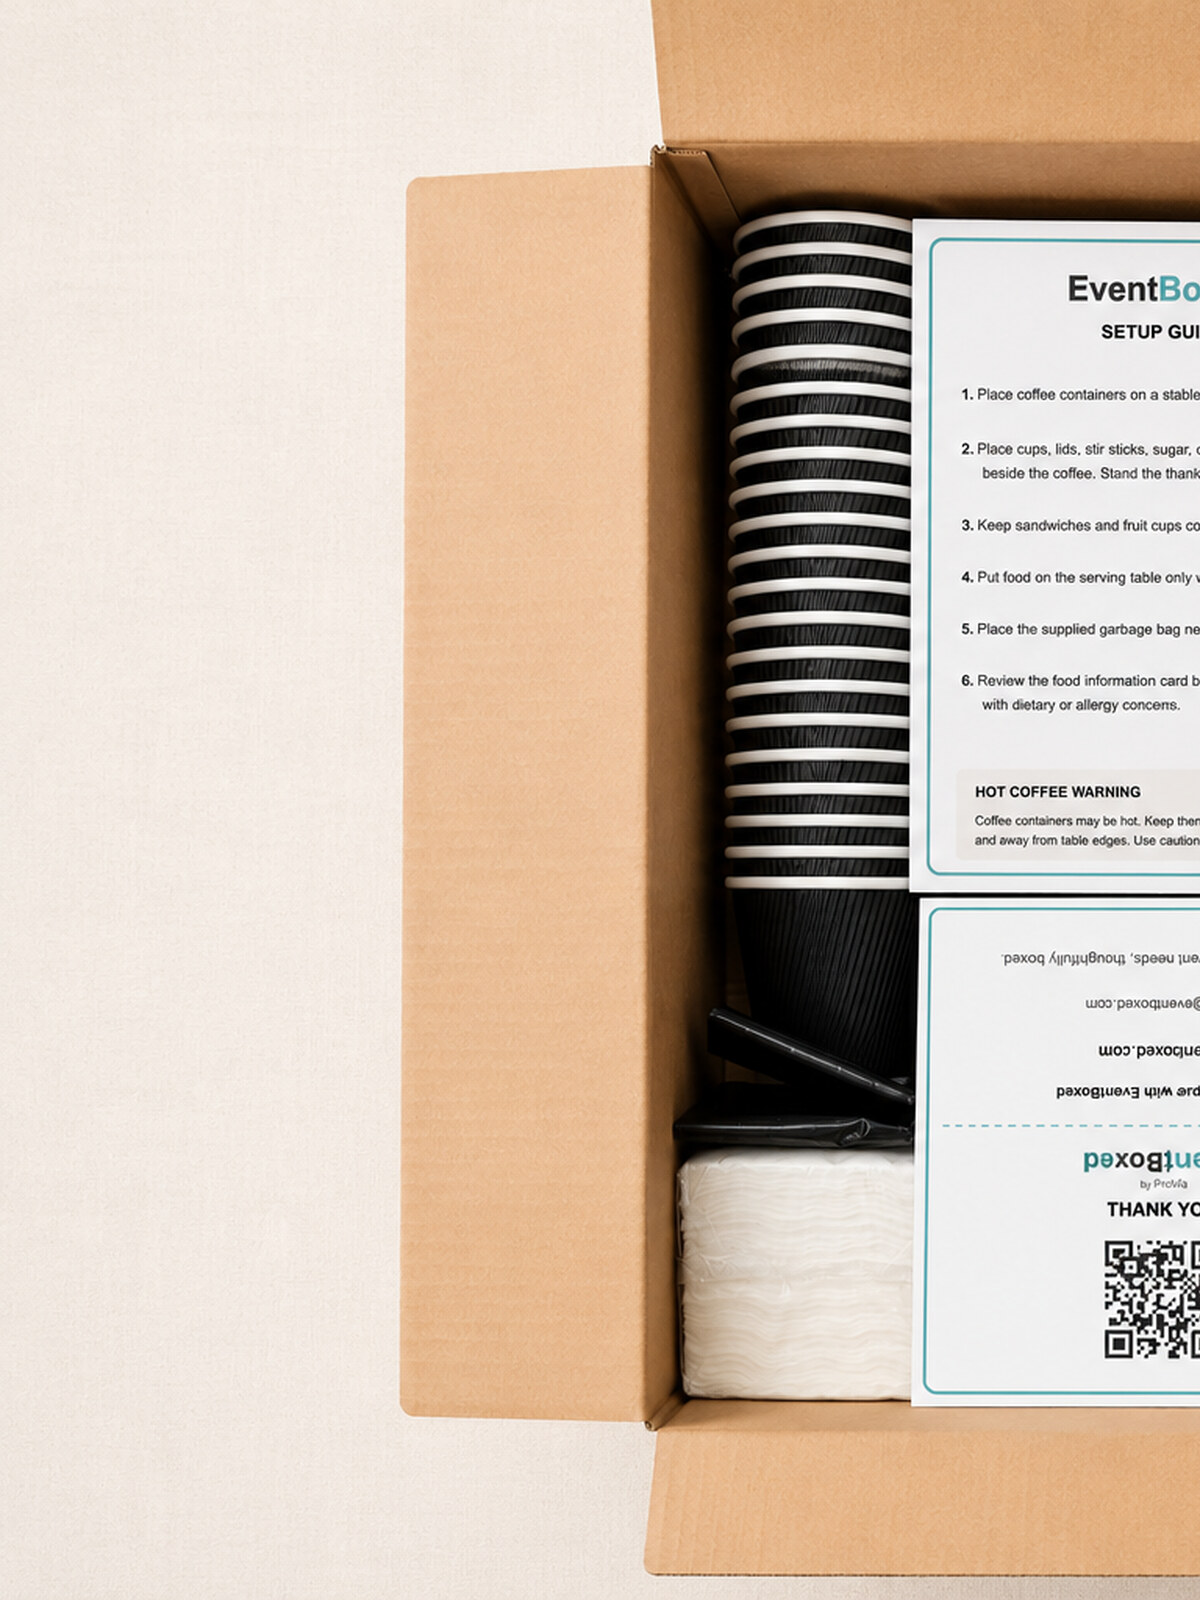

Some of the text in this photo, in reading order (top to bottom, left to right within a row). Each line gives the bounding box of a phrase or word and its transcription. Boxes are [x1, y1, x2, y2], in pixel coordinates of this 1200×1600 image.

[1101, 323, 1164, 340] SETUP
[961, 387, 974, 401] 1.
[977, 387, 1014, 401] Place
[1016, 387, 1056, 401] coffee
[1058, 388, 1127, 401] containers
[1129, 390, 1147, 401] on
[1149, 390, 1159, 401] a
[961, 442, 975, 456] 2.
[977, 441, 1014, 456] Place
[1016, 444, 1052, 458] cups,
[1055, 442, 1082, 457] lids,
[1084, 442, 1106, 456] stir
[1108, 442, 1149, 457] sticks,
[1152, 445, 1192, 459] sugar,
[982, 466, 1026, 480] beside
[1028, 466, 1050, 480] the
[1052, 466, 1097, 480] coffee.
[1100, 466, 1139, 480] Stand
[1141, 466, 1163, 480] the
[961, 518, 975, 532] 3.
[977, 518, 1012, 534] Keep
[1014, 518, 1092, 532] sandwiches
[1094, 519, 1120, 532] and
[1122, 518, 1148, 532] fruit
[1150, 521, 1183, 535] cups
[960, 570, 975, 584] 4.
[977, 570, 1000, 584] Put
[1002, 570, 1032, 584] food
[1034, 573, 1052, 584] on
[1054, 571, 1076, 584] the
[1078, 571, 1127, 587] serving
[1129, 571, 1163, 584] table
[1164, 571, 1193, 587] only
[961, 622, 974, 636] 5.
[977, 622, 1014, 636] Place
[1016, 622, 1039, 636] the
[1041, 622, 1096, 638] supplied
[1098, 622, 1153, 639] garbage
[1156, 622, 1181, 639] bag
[960, 673, 974, 687] 6.
[977, 673, 1026, 687] Review
[1027, 674, 1050, 687] the
[1052, 673, 1081, 687] food
[1084, 673, 1157, 687] information
[1159, 674, 1189, 687] card
[981, 697, 1009, 711] with
[1011, 698, 1056, 714] dietary
[1058, 700, 1074, 711] or
[1075, 698, 1120, 714] allergy
[975, 785, 1142, 799] HOT COFFEE WARNING
[974, 814, 1013, 827] Coffee
[1014, 815, 1074, 827] containers
[1075, 816, 1101, 829] may
[1102, 815, 1118, 827] be
[1119, 815, 1142, 827] hot.
[1144, 815, 1175, 829] Keep
[974, 834, 997, 846] and
[999, 836, 1030, 849] away
[1031, 834, 1059, 847] from
[1060, 834, 1090, 847] table
[1091, 834, 1131, 849] edges.
[1133, 834, 1157, 847] Use
[1158, 834, 1200, 847] caution
[1000, 953, 1046, 967] boxed.
[1048, 950, 1127, 967] thoughtfully
[1130, 952, 1175, 967] needs,
[1055, 1086, 1141, 1100] EventBoxed
[1143, 1085, 1174, 1100] with
[1106, 1200, 1174, 1218] THANK
